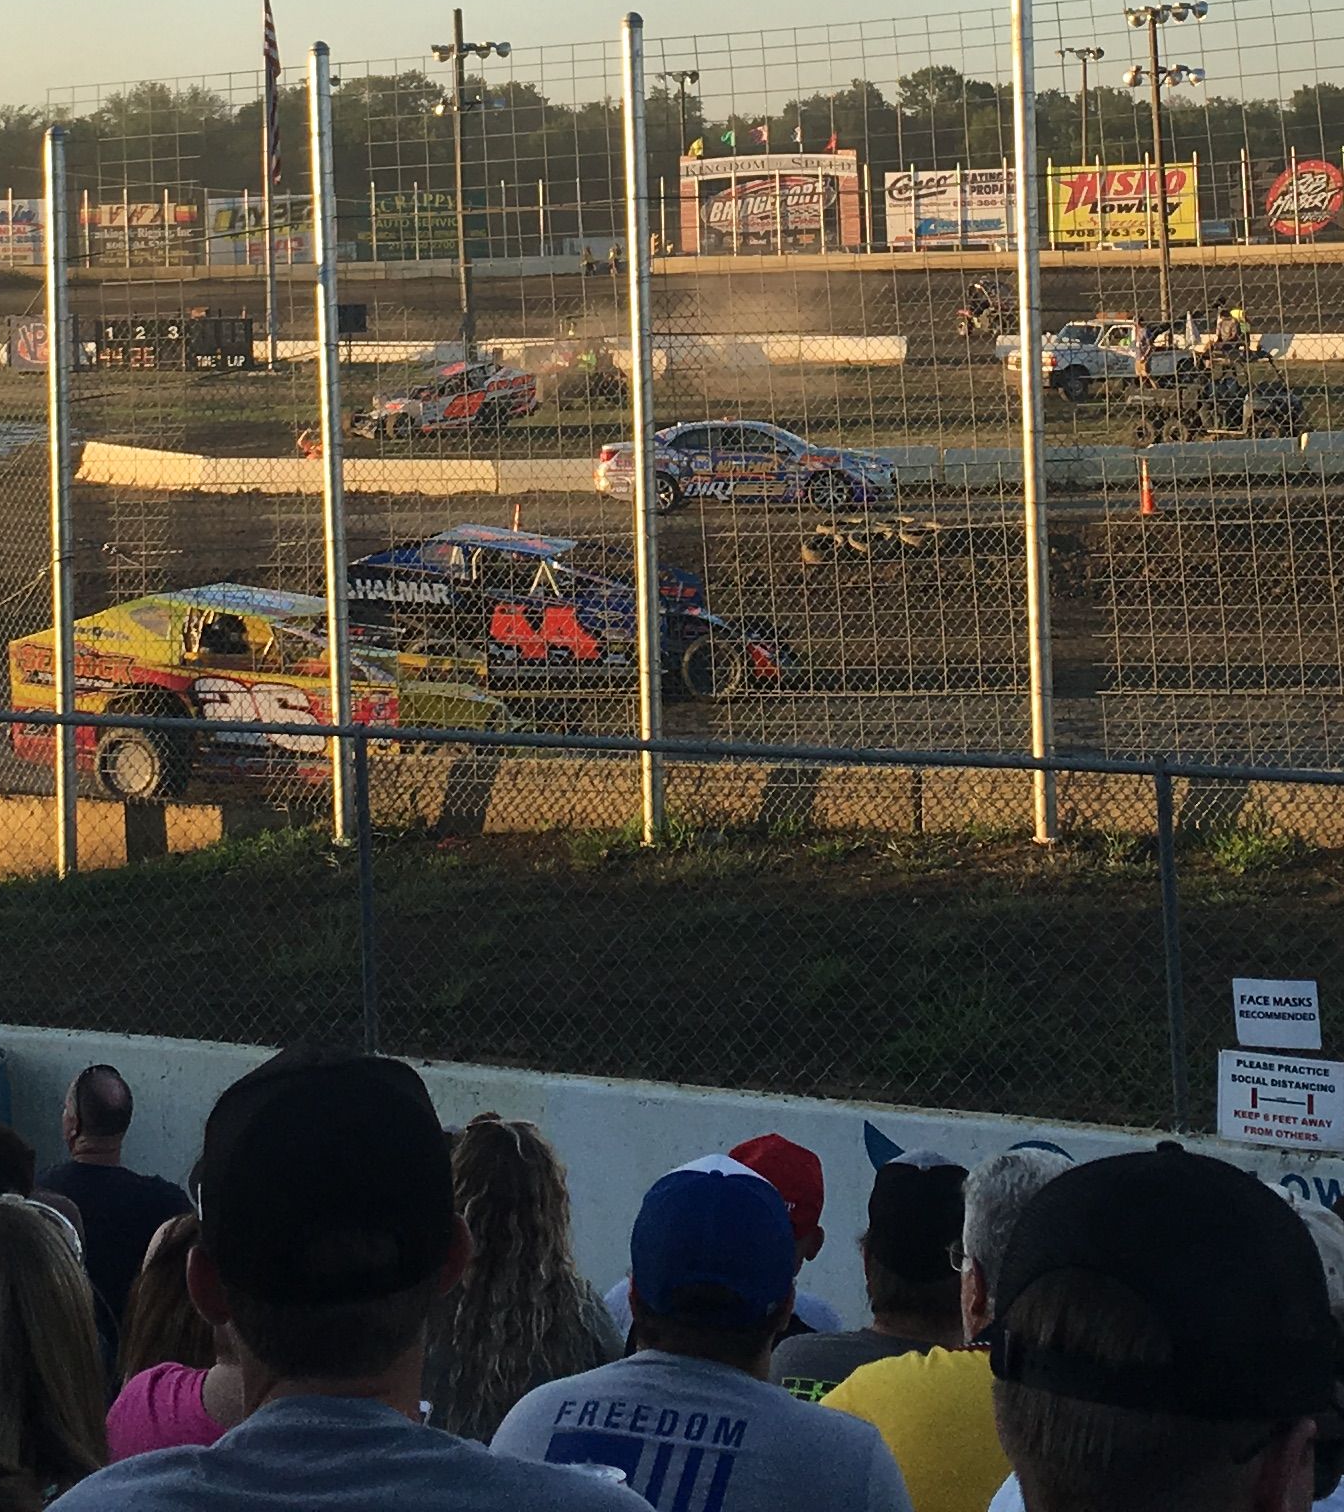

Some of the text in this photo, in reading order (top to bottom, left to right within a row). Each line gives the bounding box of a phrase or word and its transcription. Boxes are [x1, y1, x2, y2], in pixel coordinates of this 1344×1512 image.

[686, 160, 766, 177] KINGDOM
[792, 157, 853, 172] SPEED
[105, 325, 180, 340] 1 2 3
[1240, 995, 1313, 1008] FACE MASKS
[1239, 1010, 1316, 1022] RECOMMENDED
[1236, 1059, 1331, 1077] PLEASE PRACTICE
[1231, 1074, 1336, 1094] SOCIAL DISTANCING
[1233, 1109, 1261, 1120] KEEP
[1272, 1113, 1299, 1125] FEET
[1301, 1116, 1333, 1129] AWAY
[1244, 1124, 1274, 1137] FROM
[553, 1399, 749, 1449] FREEDOM
